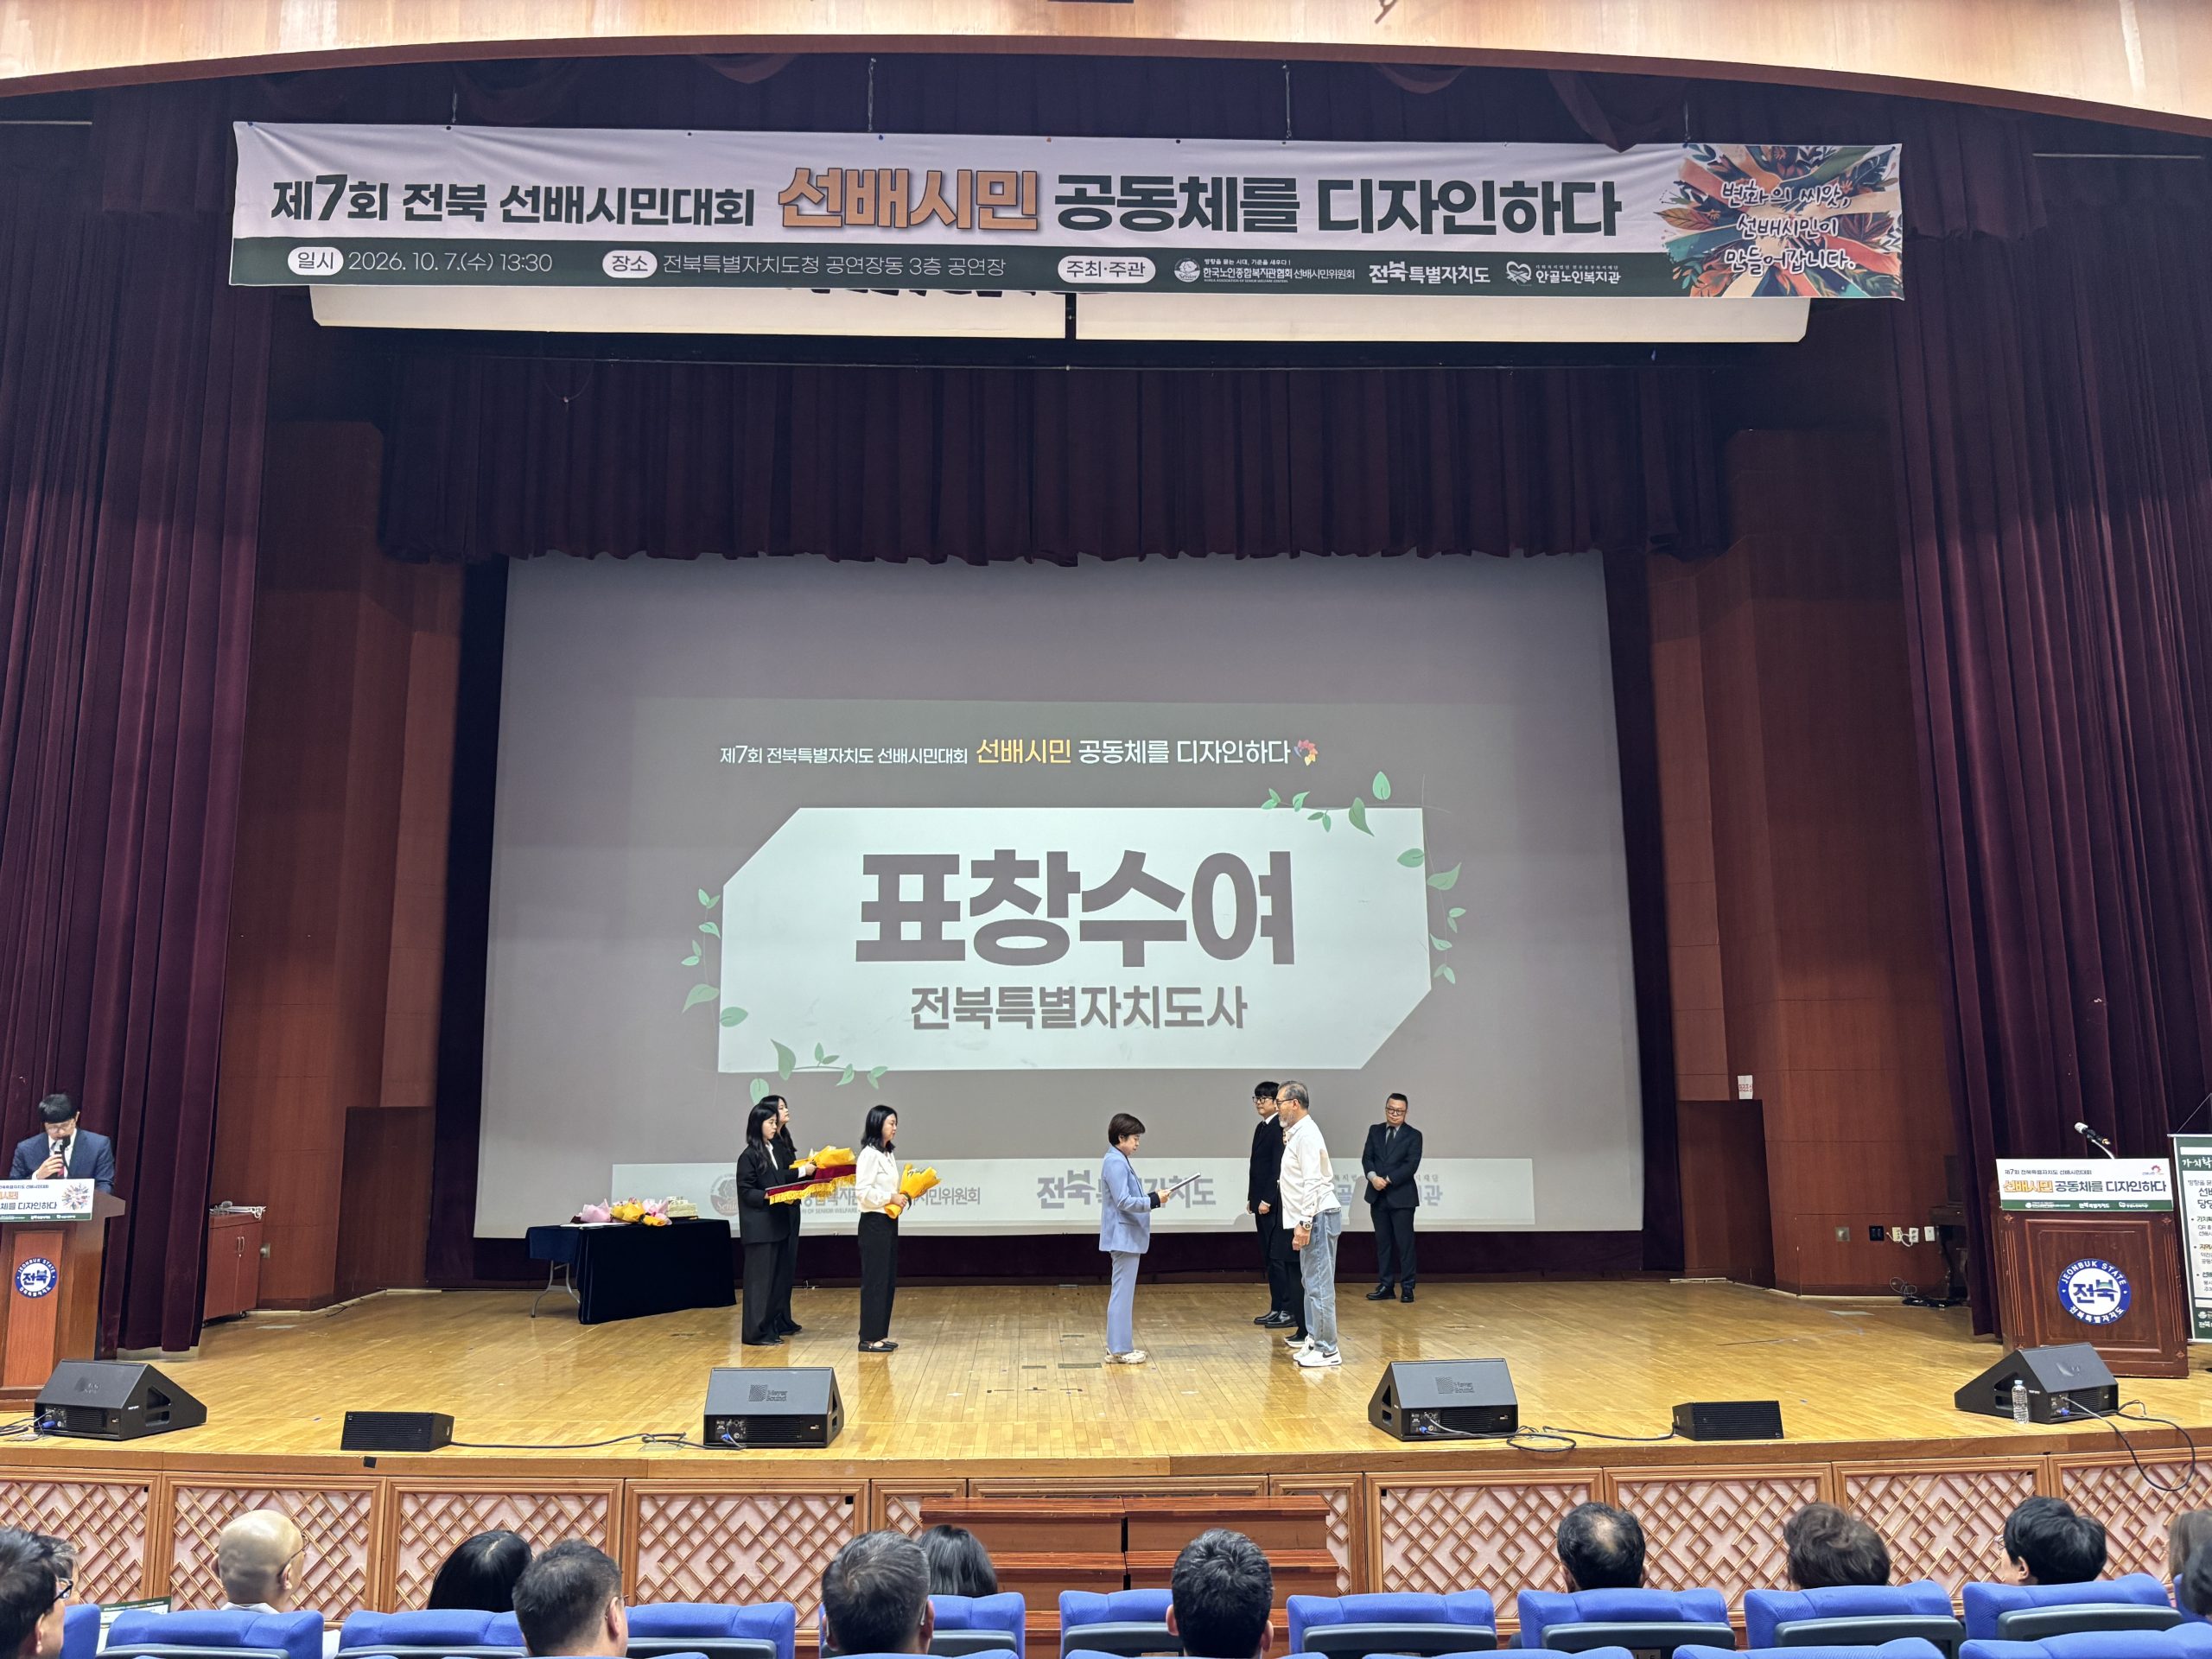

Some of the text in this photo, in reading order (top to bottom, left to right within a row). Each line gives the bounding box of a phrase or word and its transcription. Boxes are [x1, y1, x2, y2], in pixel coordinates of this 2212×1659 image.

[270, 168, 1623, 237] 제7회 전북 선배시민대회 선배시민 공동체를 디자인하다
[1721, 179, 1852, 209] 변화의 씨앗,
[1736, 214, 1840, 239] 선배시민이
[296, 251, 553, 272] 일시 2026. 10. 7.(수) 13:30
[611, 254, 1007, 276] 장소 전북특별자치도청 공연장동 3층 공연장
[1066, 260, 1147, 278] 주최·주관
[1203, 267, 1356, 280] 한국노인종합복지관협회 선배시민위원회
[1369, 261, 1491, 285] 전북특별자치도
[1724, 245, 1857, 278] 만들어갑니다.
[1535, 270, 1622, 284] 안골노인복지관
[720, 739, 1292, 765] 제7회 전북특별자치도 선배시민대회 선배시민 공동체를 디자인하다
[855, 849, 1296, 968] 표창수여
[910, 985, 1249, 1031] 전북특별자치도사
[1037, 1169, 1217, 1209] 전북자치도
[2003, 1179, 2167, 1192] 선배시민 공동체를 디자인하다
[17, 1201, 58, 1210] 디자인하다
[22, 1269, 49, 1286] 전북
[2061, 1260, 2127, 1286] JEONBUK STATE
[2072, 1279, 2119, 1304] 전북
